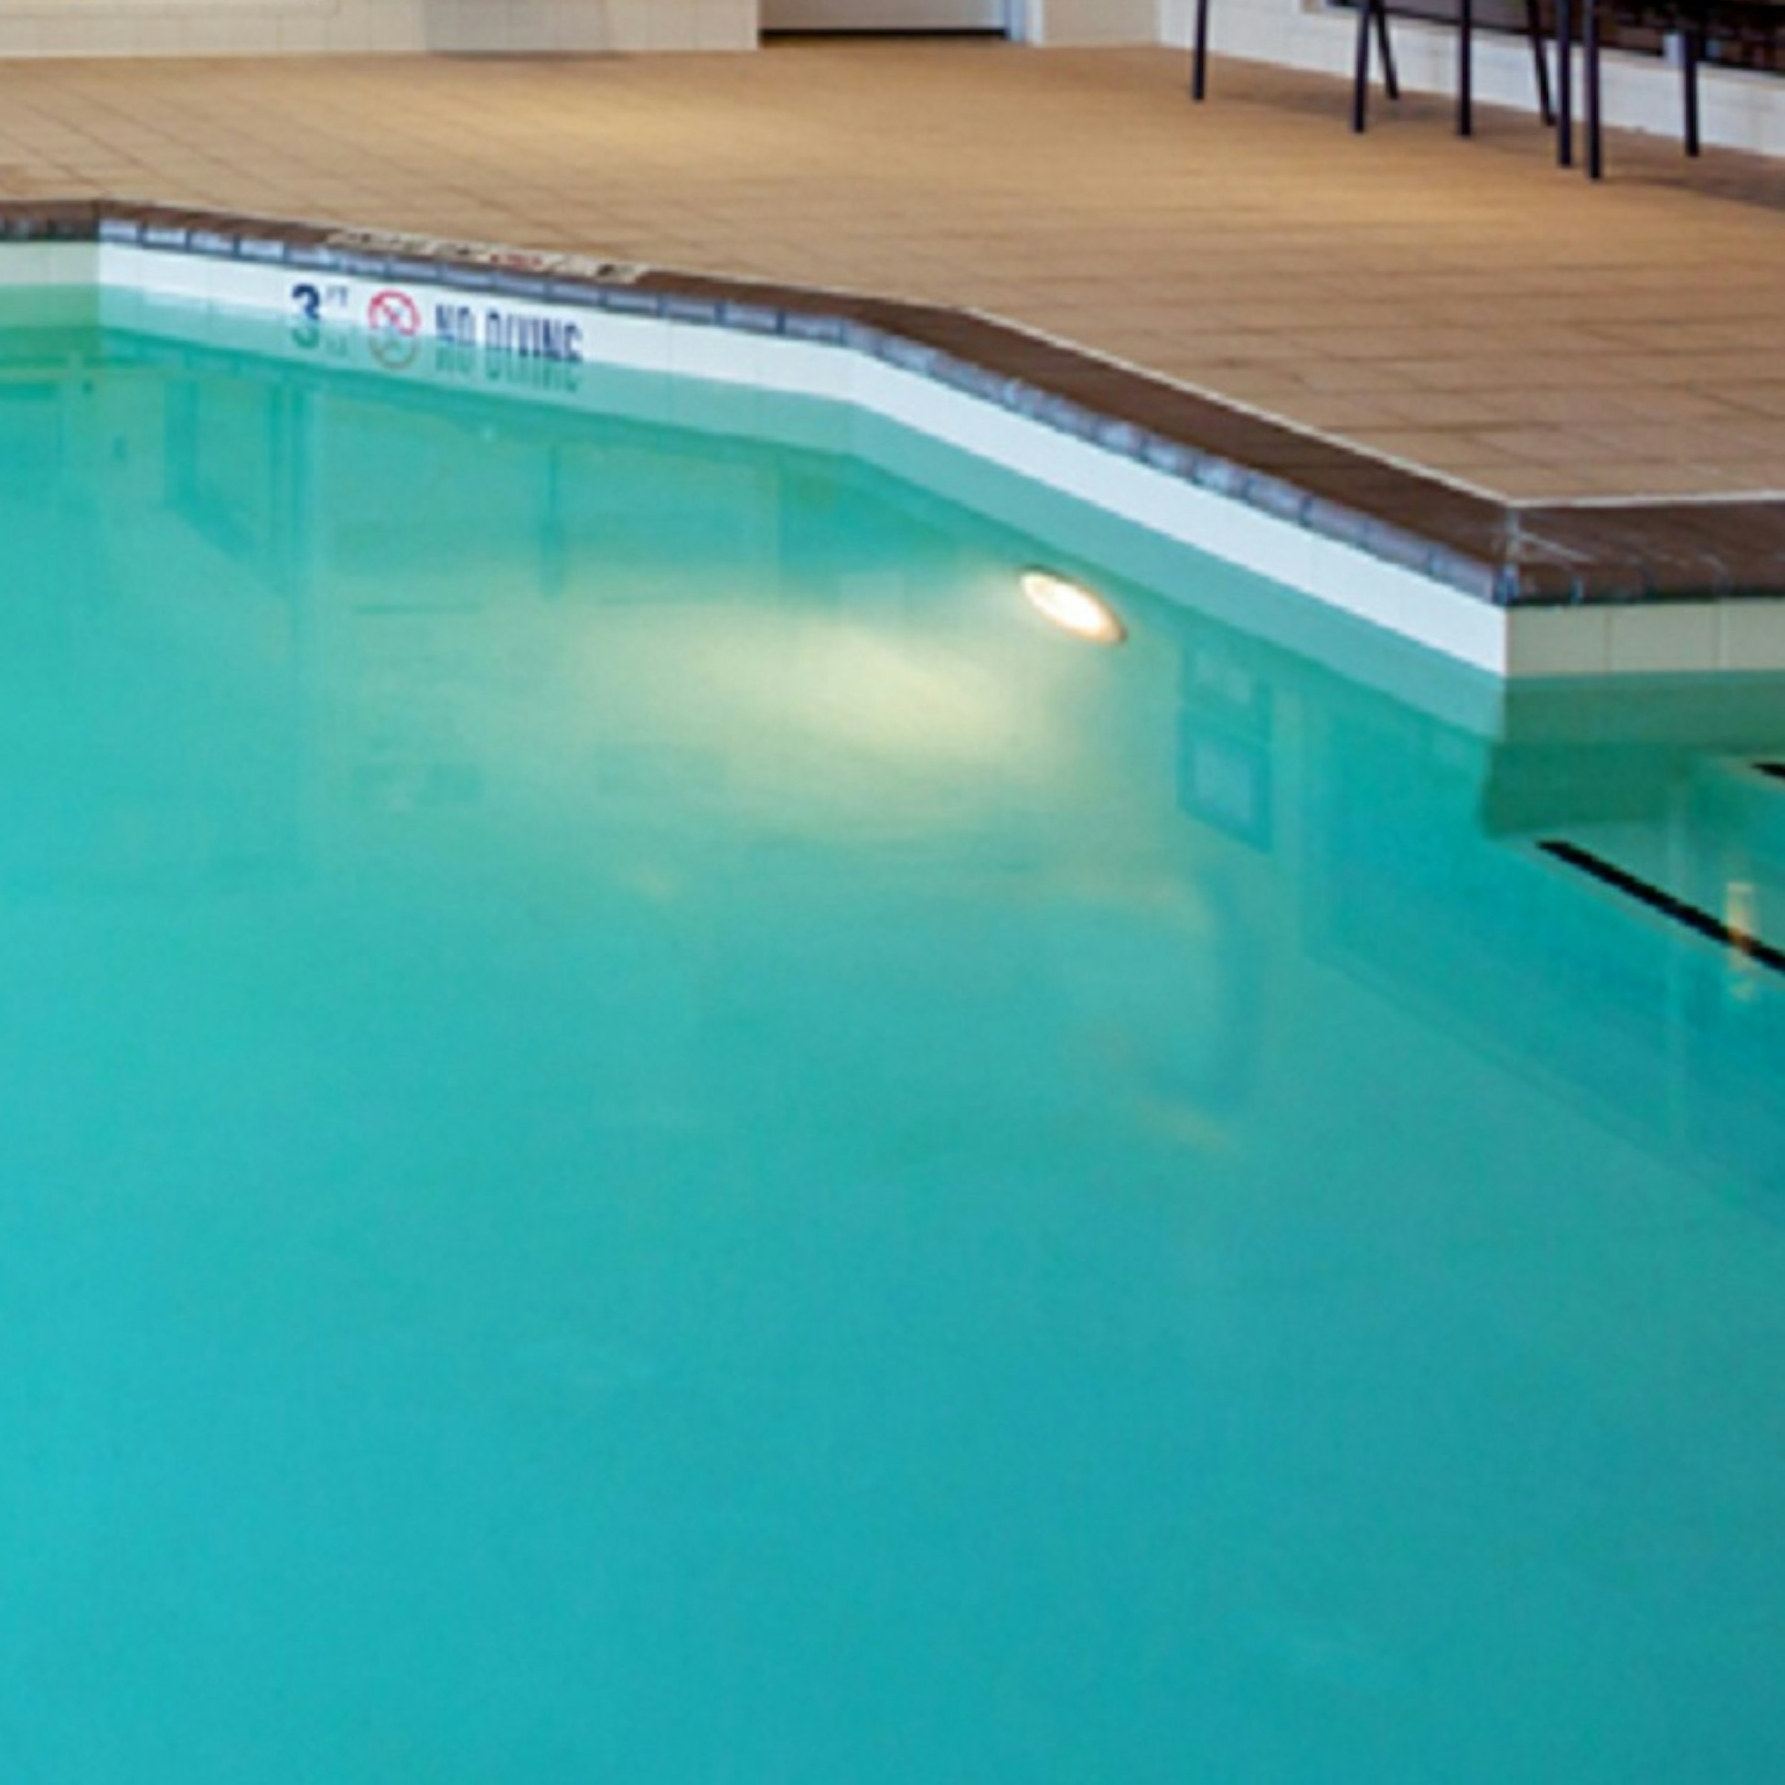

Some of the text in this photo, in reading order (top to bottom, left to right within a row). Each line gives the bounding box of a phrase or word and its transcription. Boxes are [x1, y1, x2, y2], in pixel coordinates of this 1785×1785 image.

[292, 284, 321, 322] 3
[435, 304, 476, 345] NO
[485, 308, 583, 362] DIVING
